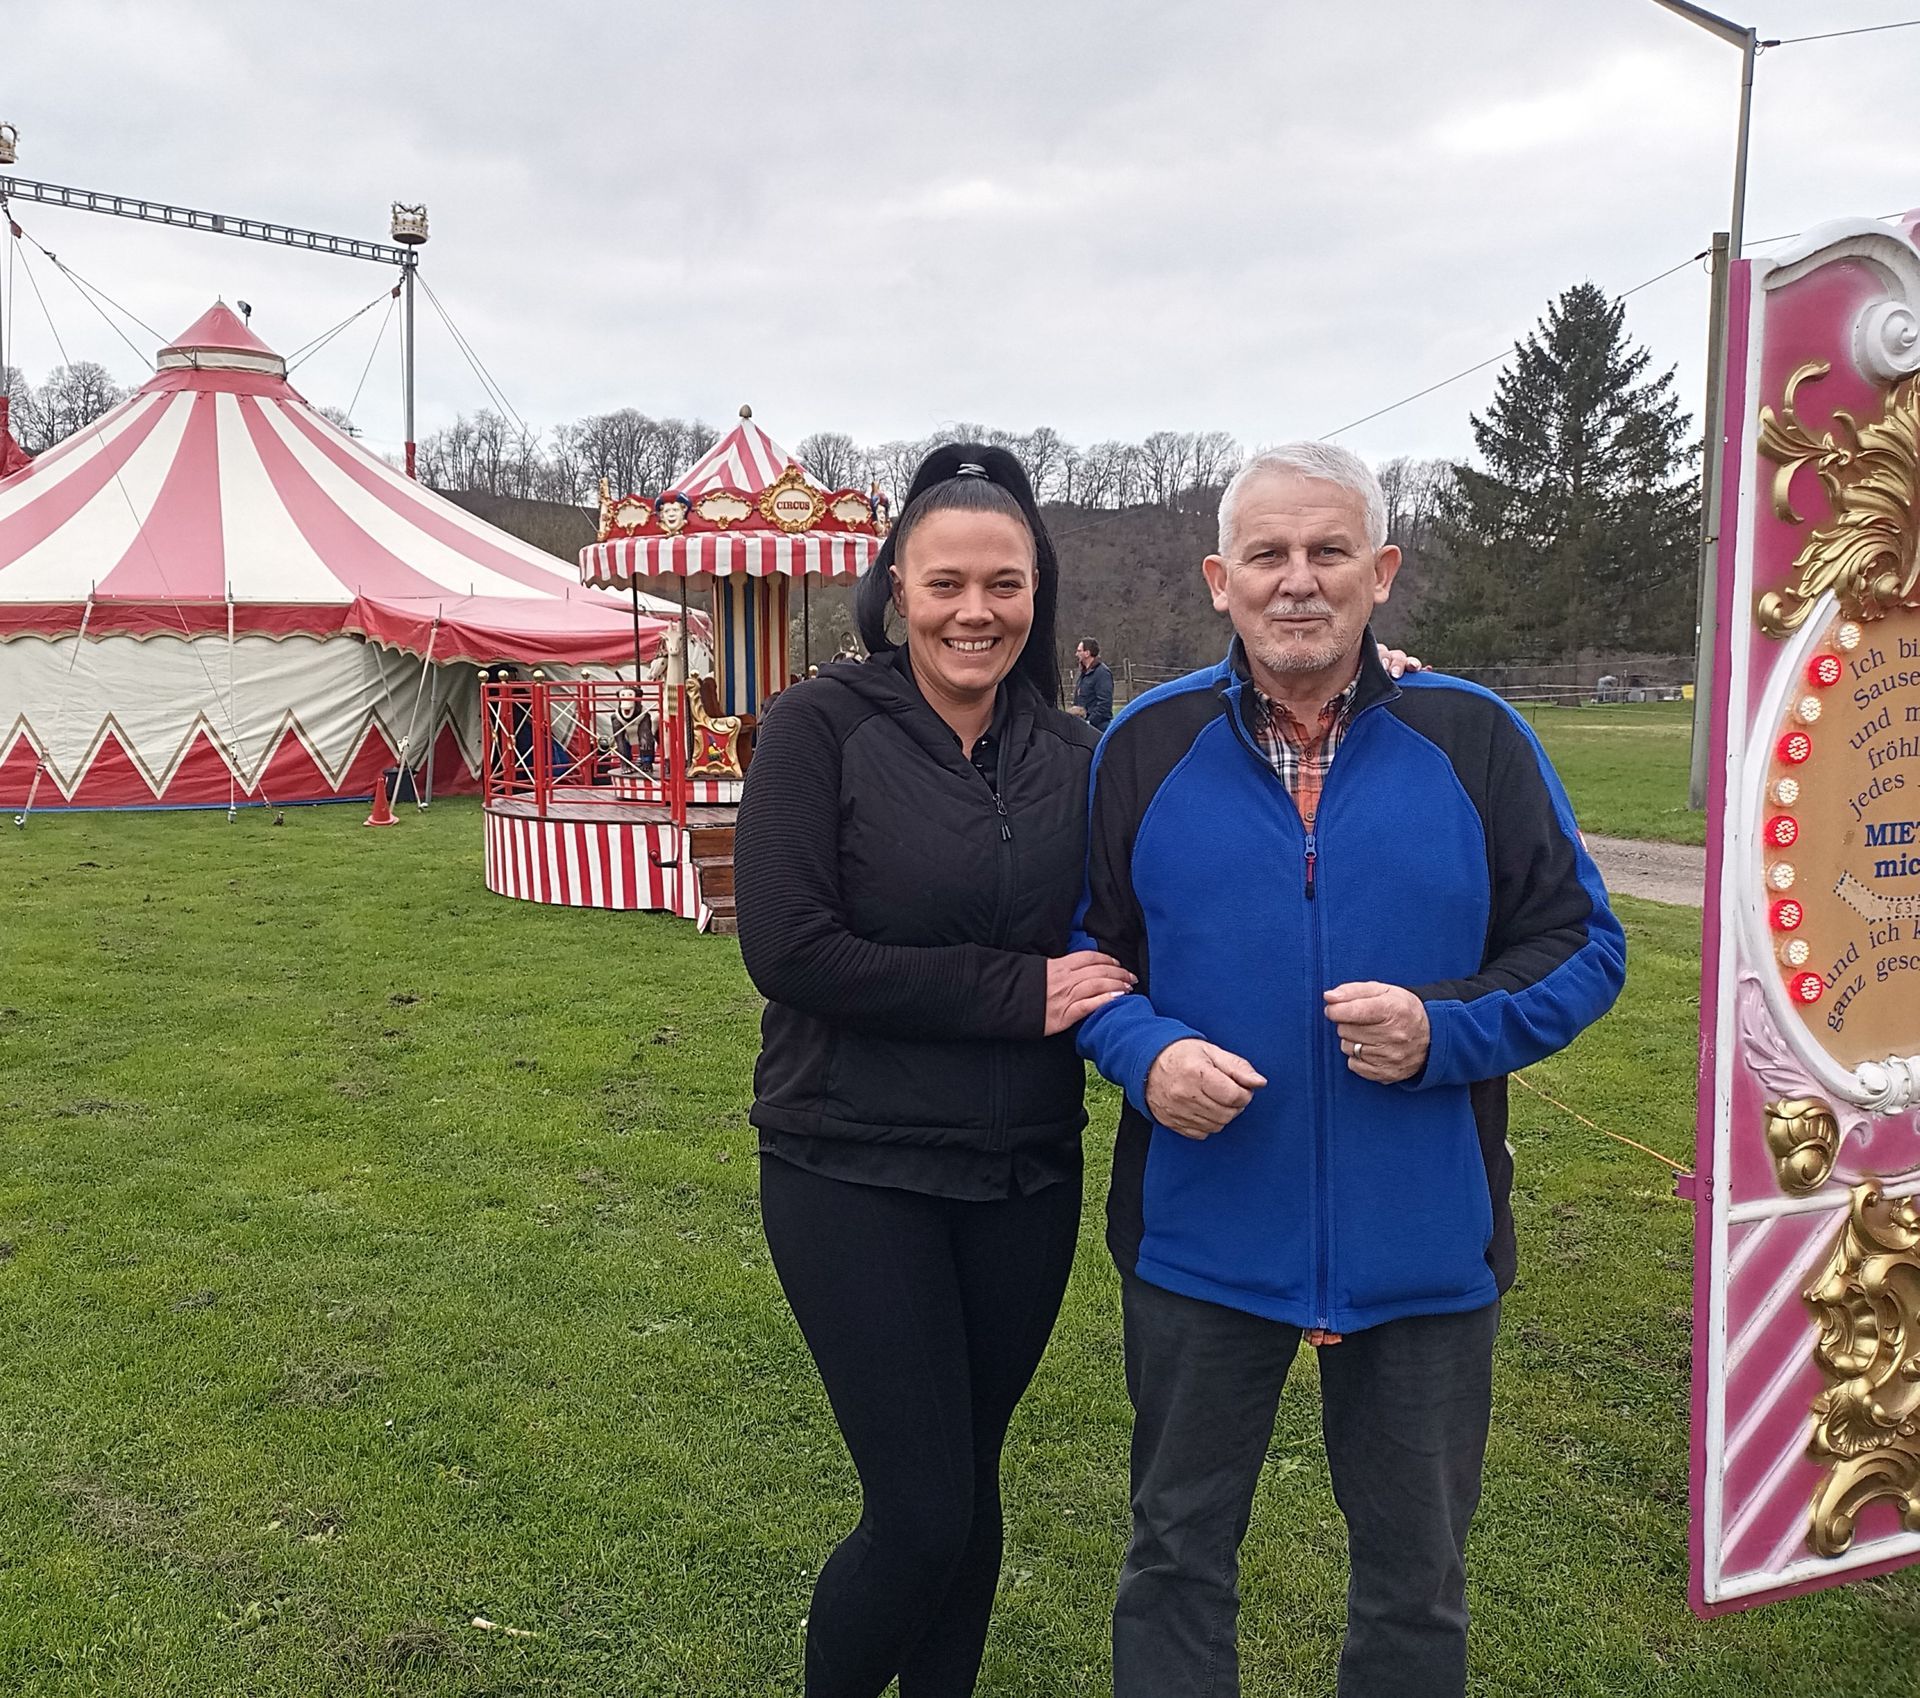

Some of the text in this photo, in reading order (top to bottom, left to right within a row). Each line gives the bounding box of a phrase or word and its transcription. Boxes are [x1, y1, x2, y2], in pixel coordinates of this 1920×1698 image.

[776, 501, 811, 511] CIRCUS
[1849, 648, 1887, 681] Ich
[1853, 671, 1920, 711] Sause
[1848, 706, 1892, 750] und
[1868, 736, 1920, 771] fröhl
[1849, 774, 1905, 822] jedes
[1864, 821, 1920, 847] MIE
[1874, 853, 1920, 878] mic
[1822, 941, 1860, 989] und
[1869, 923, 1900, 949] ich
[1827, 974, 1866, 1033] ganz
